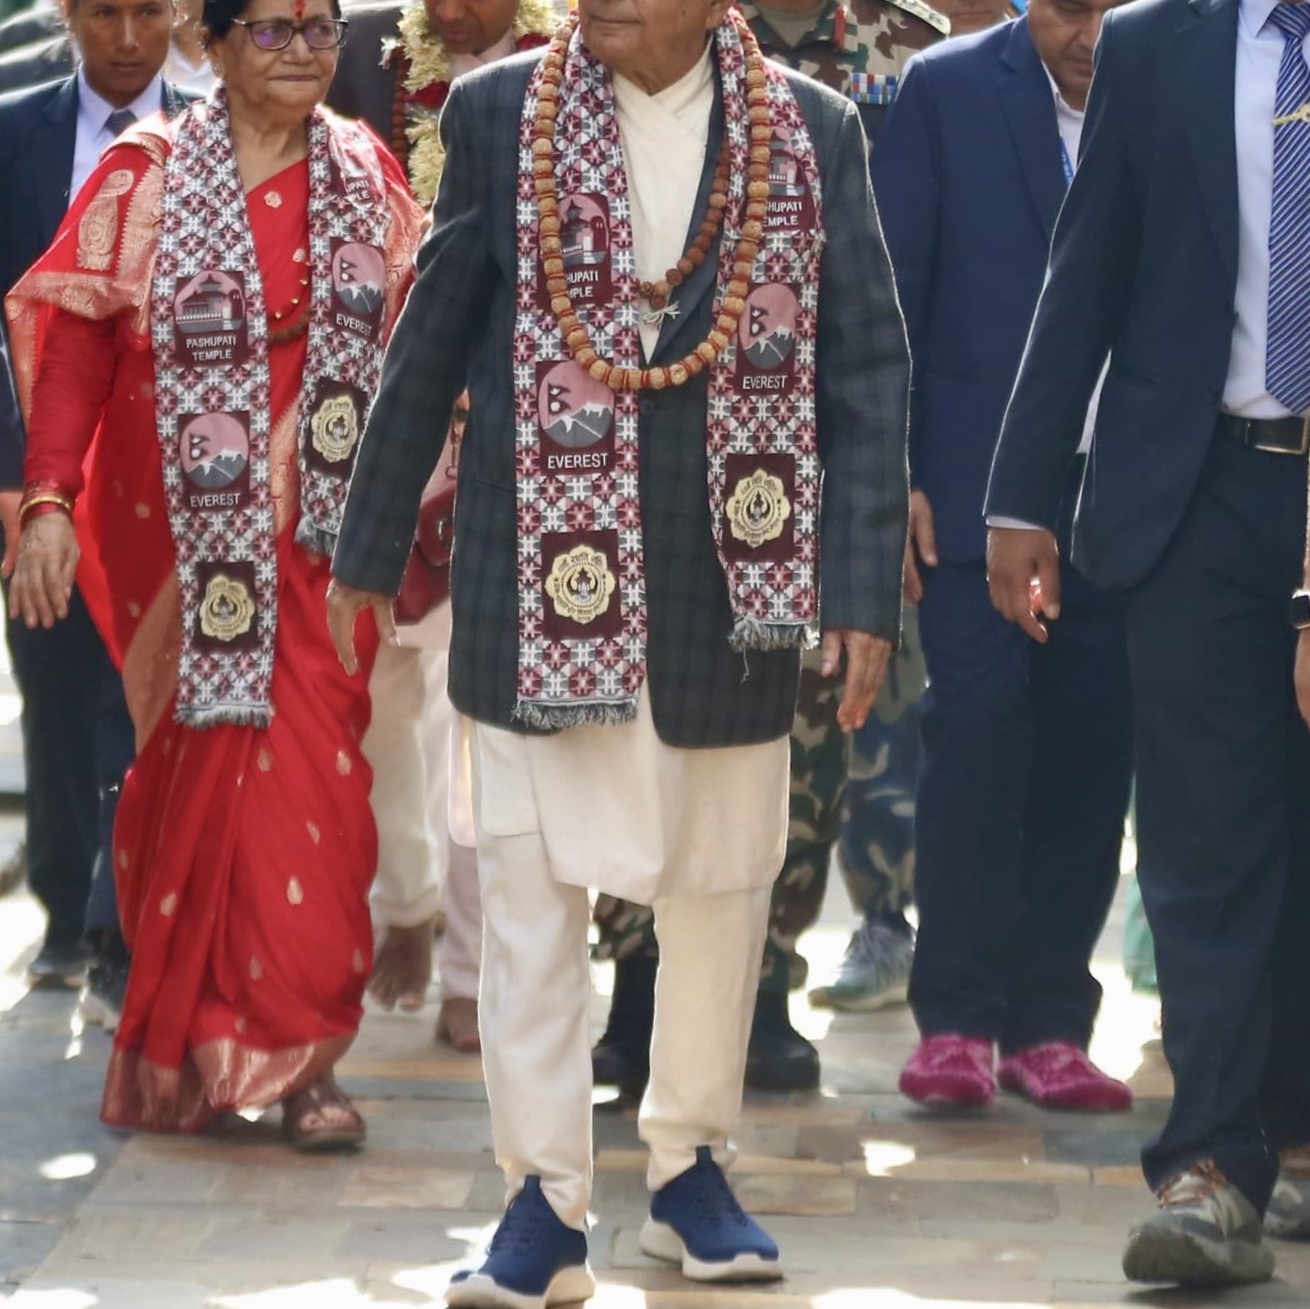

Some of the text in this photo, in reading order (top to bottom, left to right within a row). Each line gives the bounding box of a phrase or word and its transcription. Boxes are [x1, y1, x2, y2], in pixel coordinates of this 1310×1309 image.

[768, 201, 803, 213] HUPATI
[763, 215, 799, 227] EMPLE
[567, 271, 599, 283] HUPATI
[336, 313, 372, 336] EVEREST
[186, 335, 236, 348] PASHUPATI
[192, 350, 233, 362] TEMPLE
[742, 375, 788, 389] EVEREST
[548, 453, 608, 469] EVEREST
[190, 493, 241, 508] EVEREST
